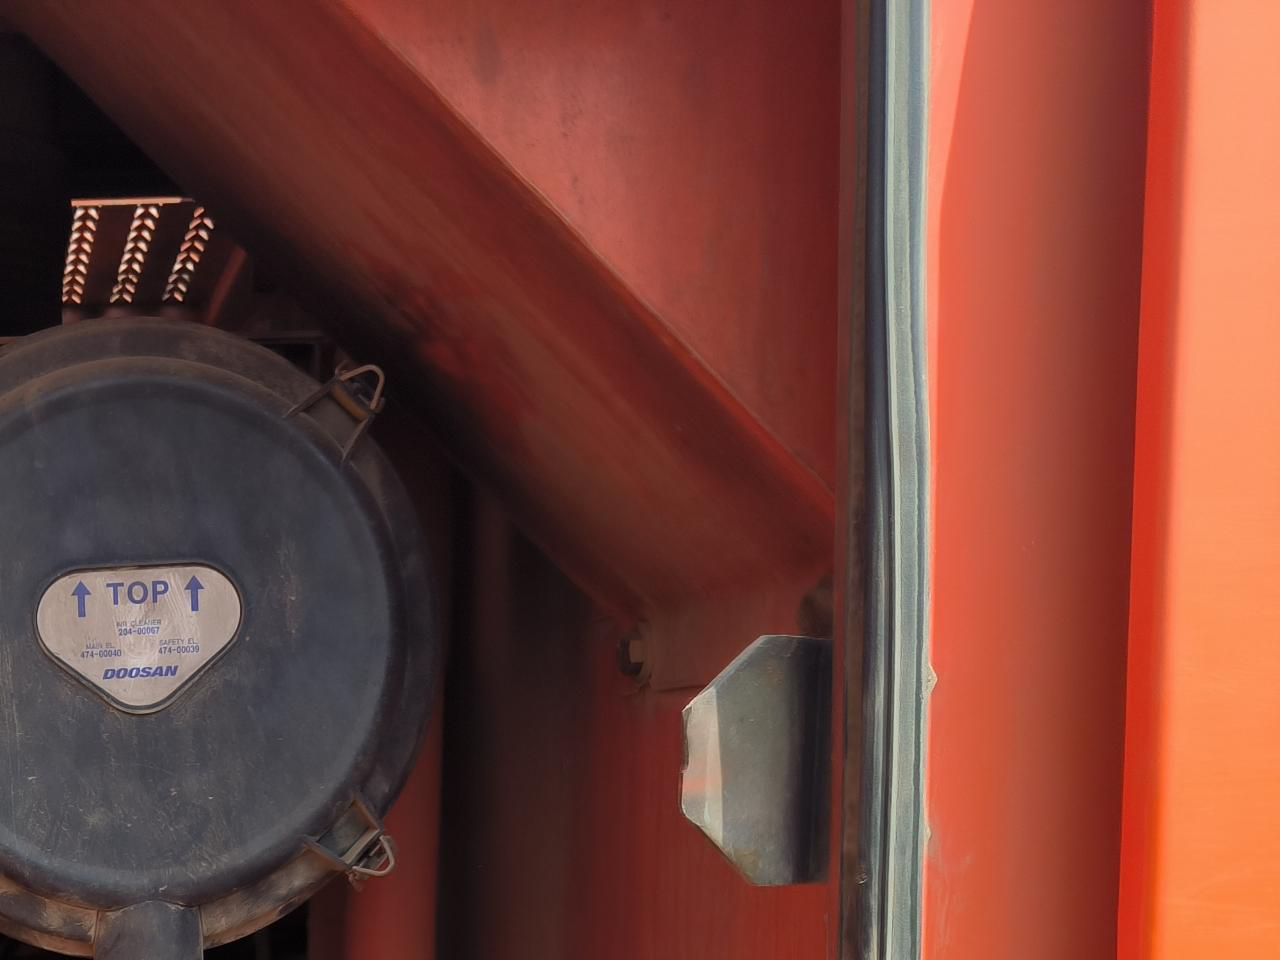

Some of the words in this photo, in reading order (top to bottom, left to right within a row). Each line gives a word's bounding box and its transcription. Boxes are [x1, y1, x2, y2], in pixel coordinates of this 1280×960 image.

[106, 580, 169, 605] TOP
[130, 618, 162, 628] CLEANER
[159, 638, 184, 646] SAFETY
[80, 649, 122, 658] 474-00040
[158, 645, 200, 655] 474-00039
[103, 665, 179, 680] DOOSAN
